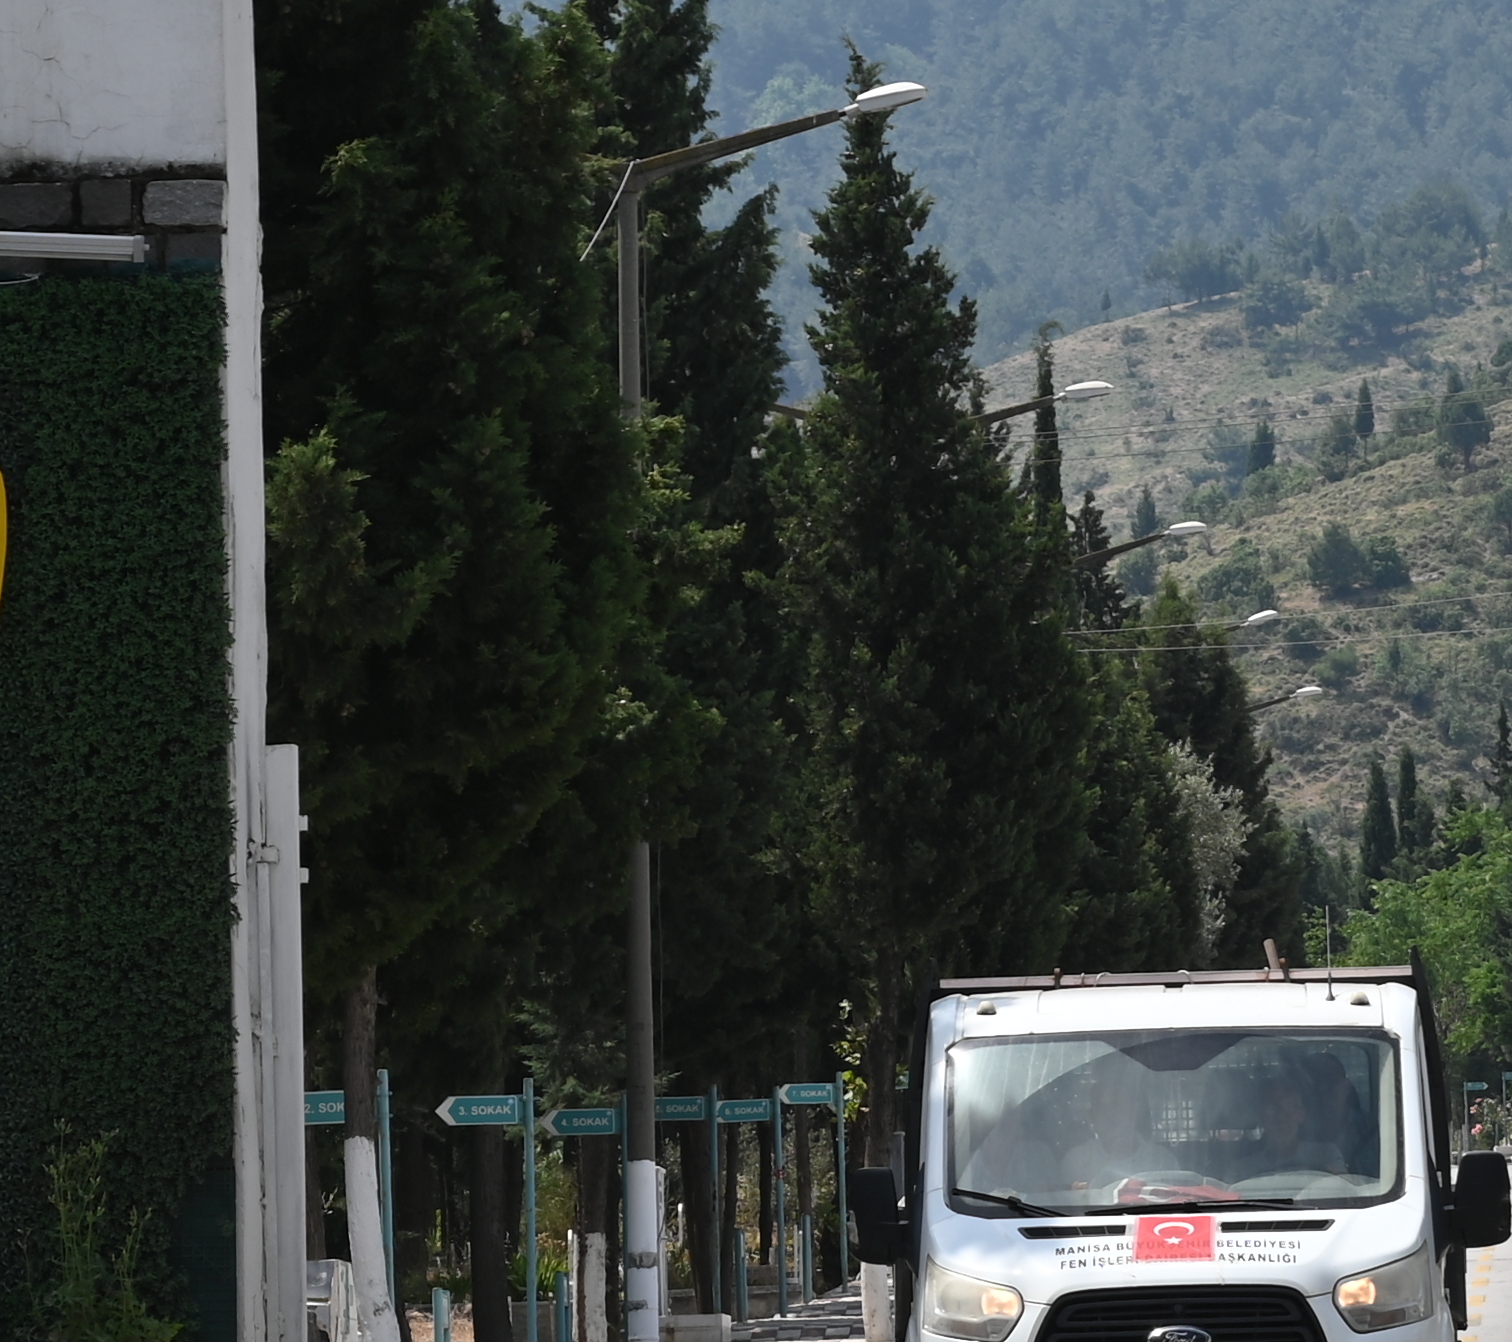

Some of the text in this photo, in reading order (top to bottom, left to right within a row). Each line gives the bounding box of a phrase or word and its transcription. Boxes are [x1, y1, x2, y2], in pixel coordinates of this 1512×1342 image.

[458, 1105, 512, 1116] 3. SOKAK
[665, 1104, 699, 1114] SOKAK
[734, 1106, 765, 1115] SOKAK
[560, 1117, 609, 1127] 4. SOKAK
[1054, 1243, 1111, 1256] MANİSA
[1216, 1238, 1301, 1250] BELEDİYESİ
[1060, 1259, 1087, 1270] FEN
